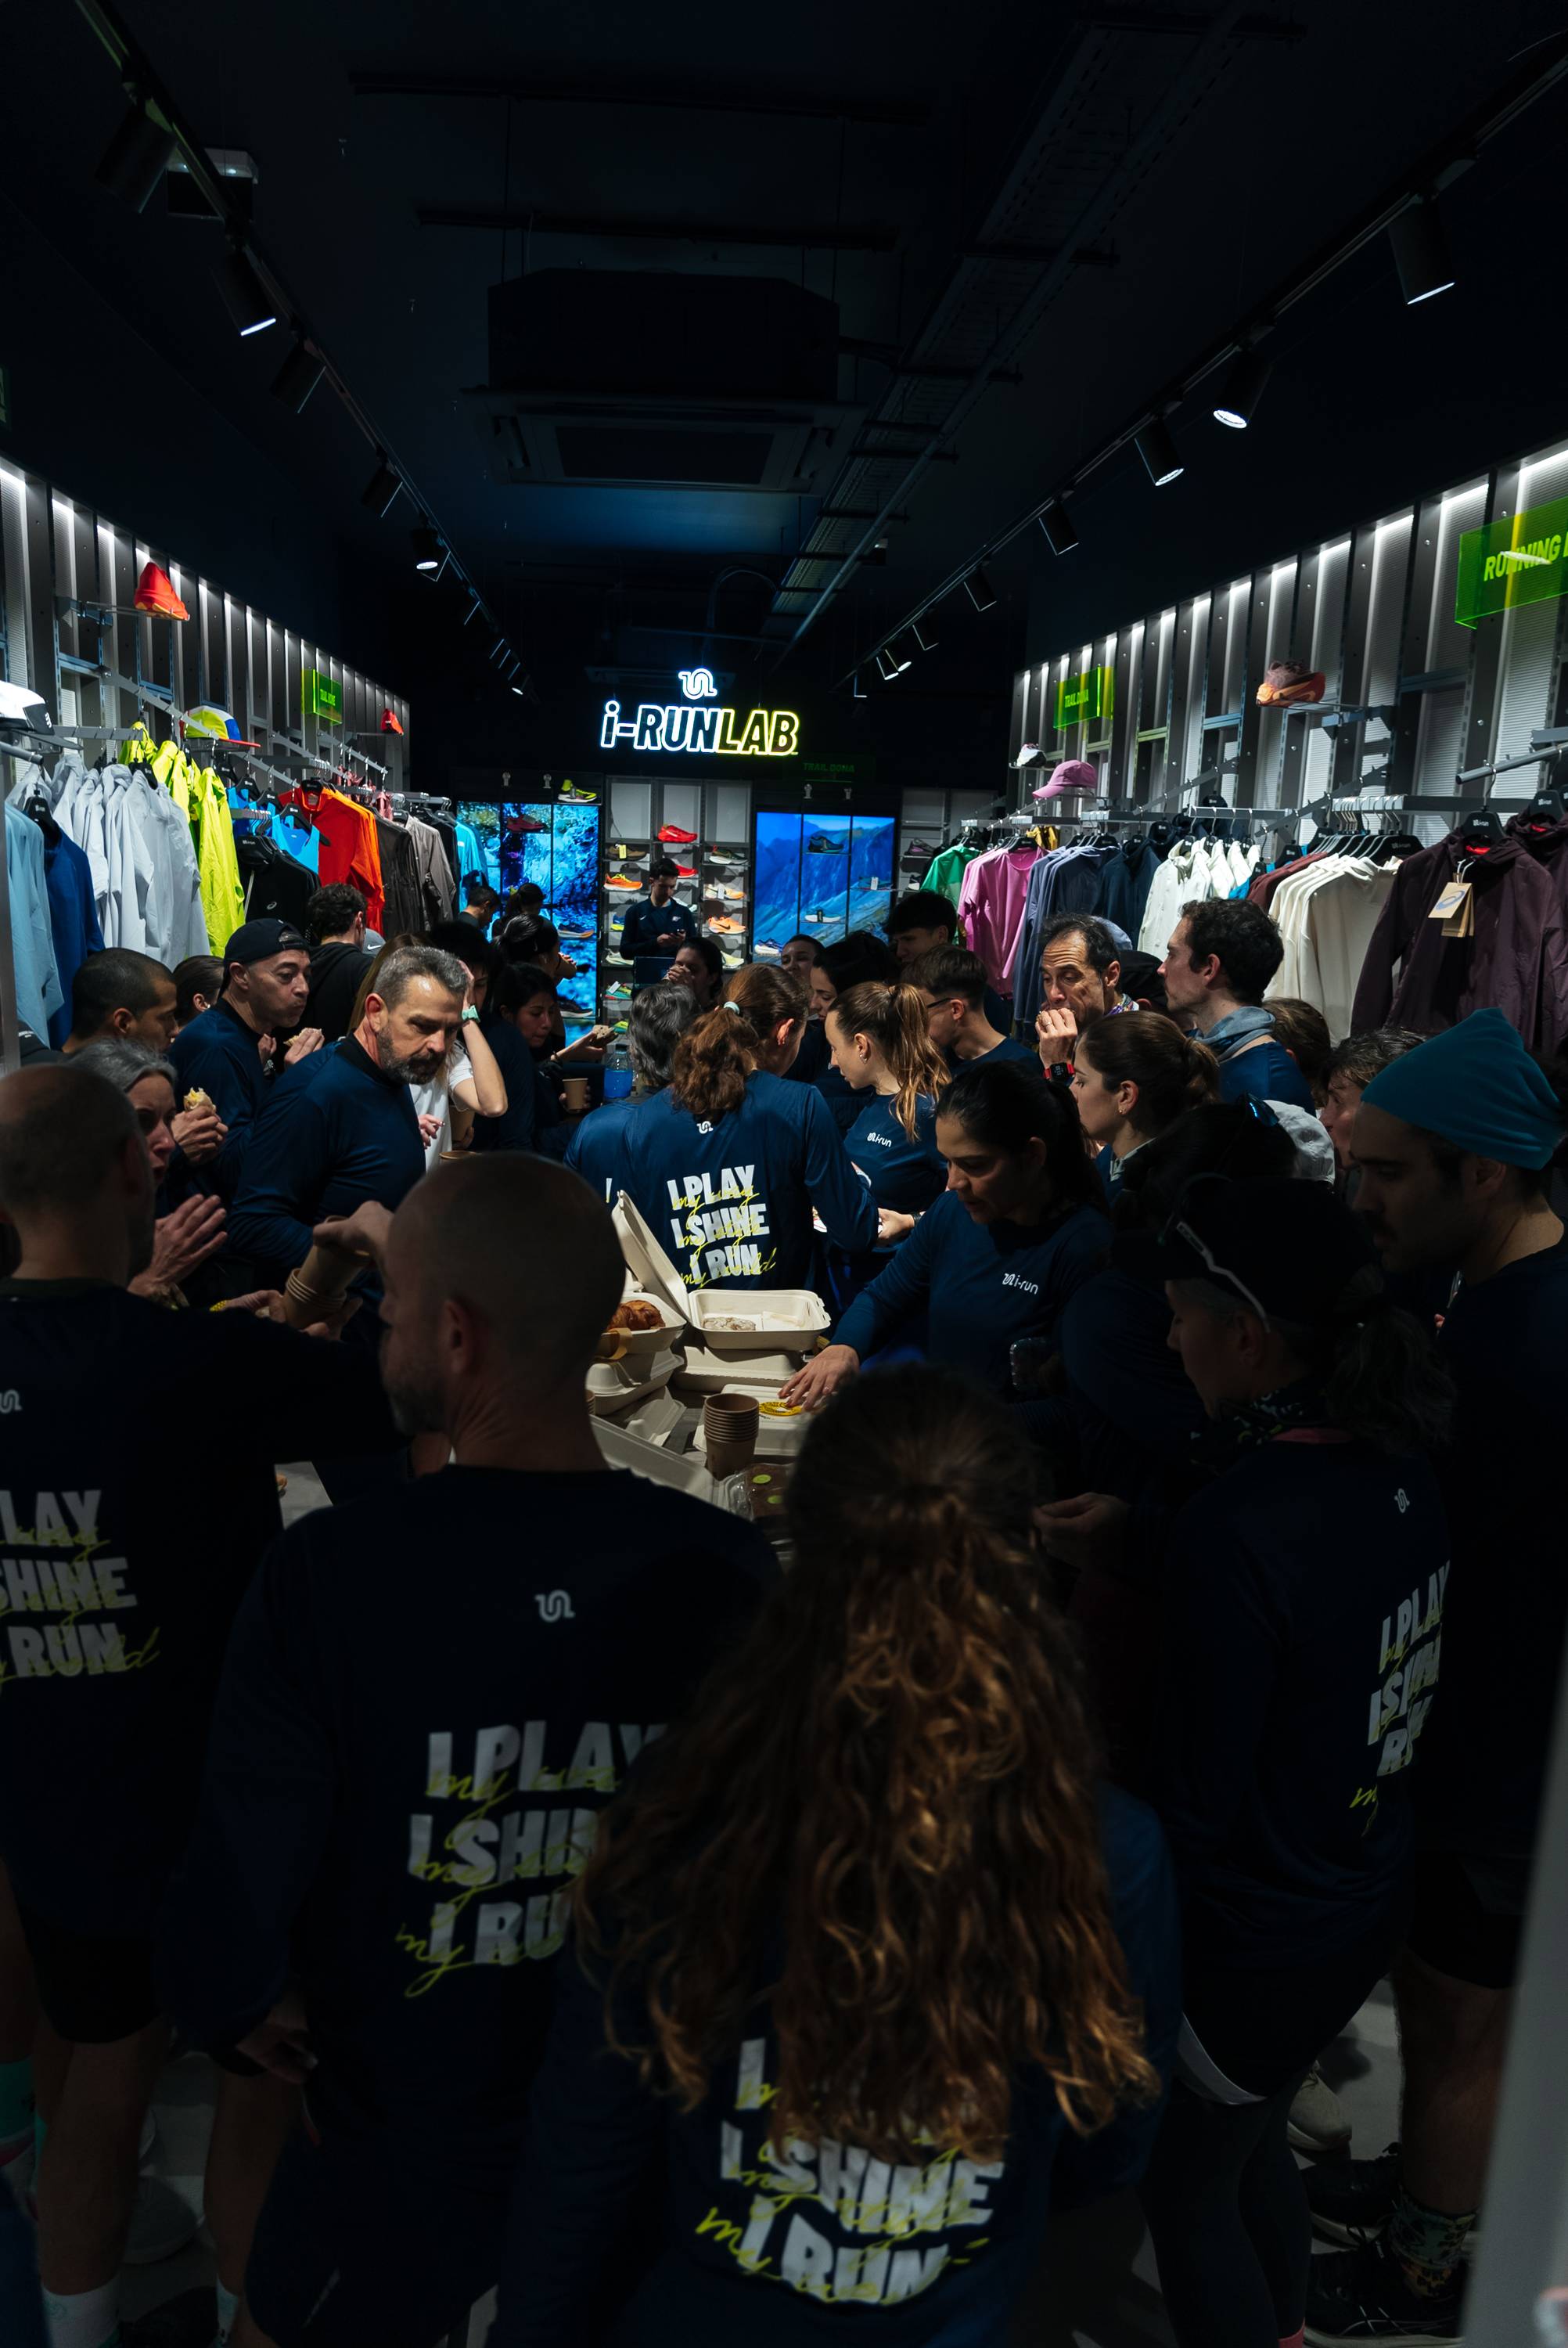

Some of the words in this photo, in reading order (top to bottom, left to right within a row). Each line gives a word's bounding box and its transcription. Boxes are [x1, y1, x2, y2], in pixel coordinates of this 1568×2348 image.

[667, 1179, 682, 1211] I
[683, 1165, 755, 1208] PLAY
[671, 1218, 685, 1249] I
[687, 1203, 770, 1246] SHINE
[689, 1254, 703, 1284] I
[705, 1244, 762, 1280] RUN
[0, 1489, 102, 1547] LAY
[0, 1556, 138, 1612] HINE
[1378, 1615, 1392, 1676] I
[1396, 1558, 1451, 1661] PLAY
[6, 1621, 128, 1678] RUN
[426, 1730, 454, 1799] I
[408, 1812, 434, 1880] I
[427, 1900, 459, 1964] I
[473, 1891, 575, 1967] RU
[735, 2036, 766, 2110] I
[719, 2118, 744, 2182] I
[767, 2134, 1005, 2236] SHINE
[780, 2212, 951, 2307] RUN
